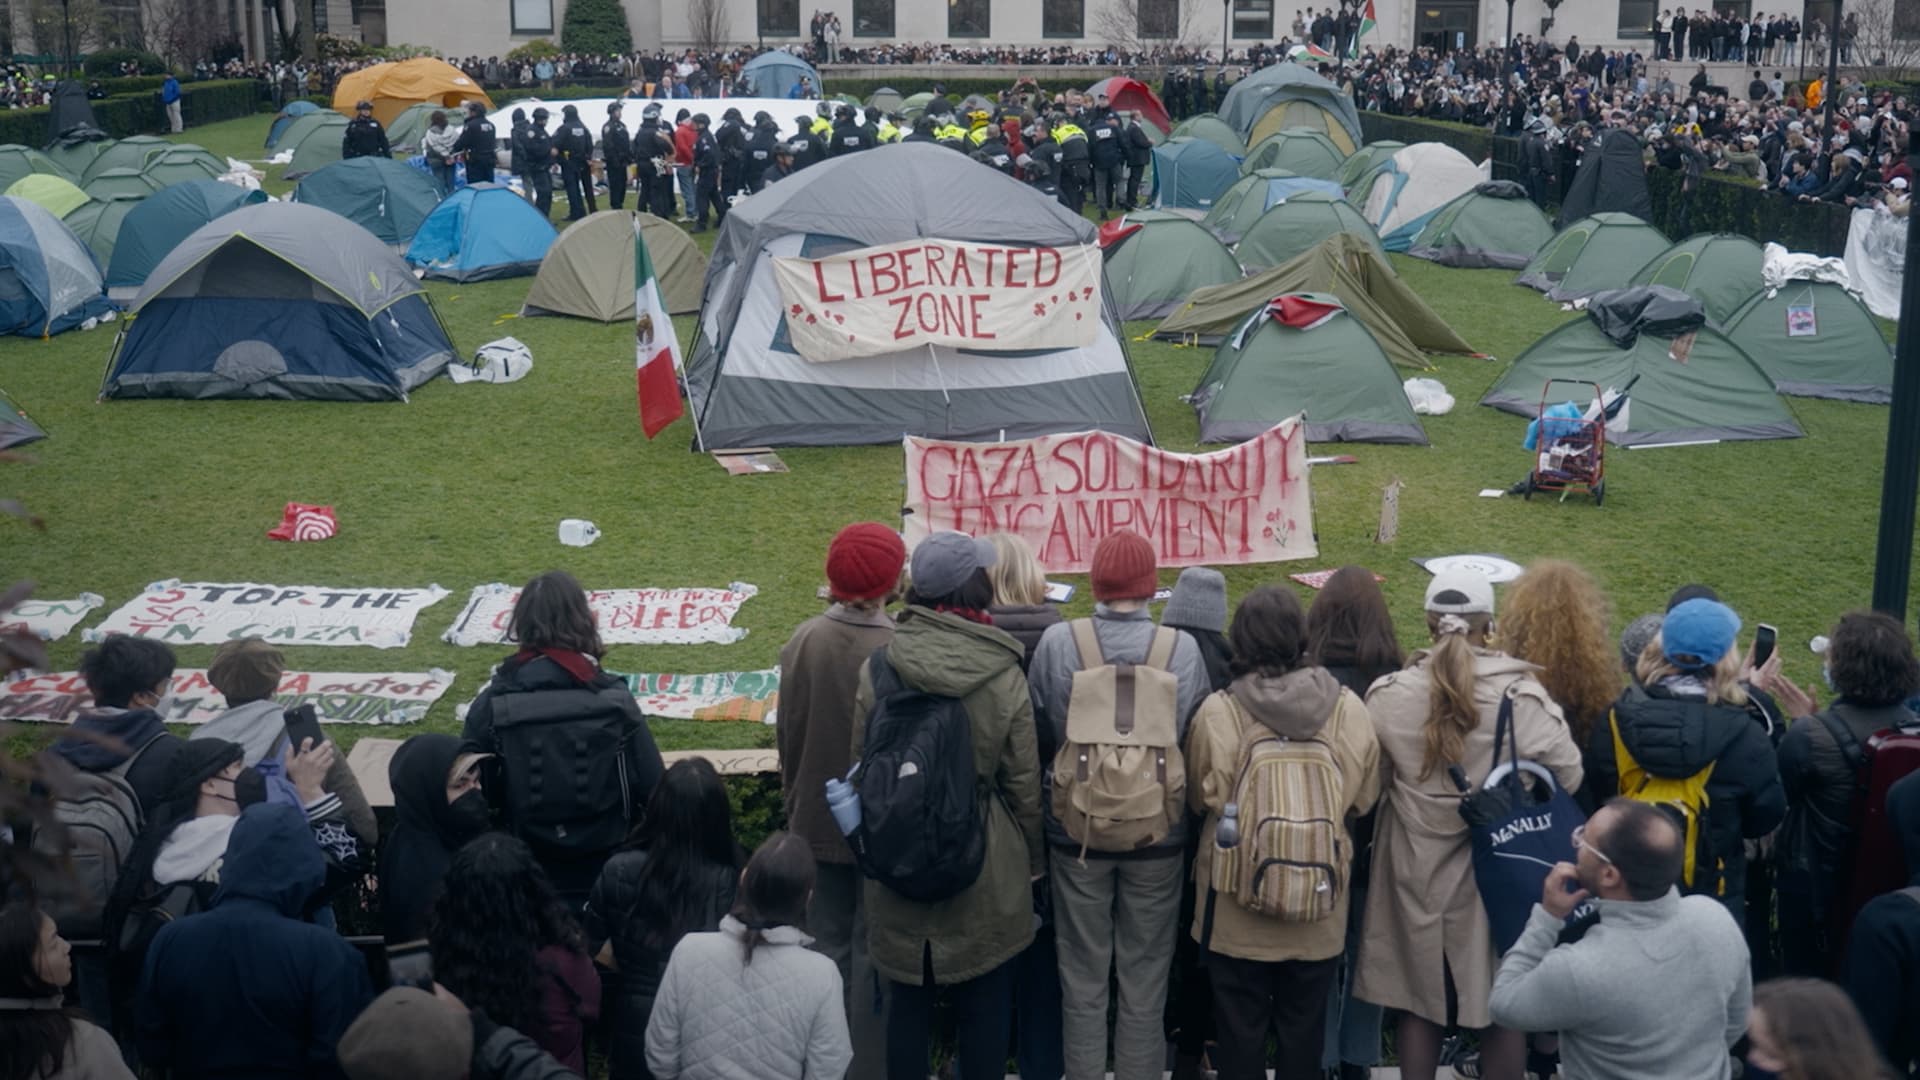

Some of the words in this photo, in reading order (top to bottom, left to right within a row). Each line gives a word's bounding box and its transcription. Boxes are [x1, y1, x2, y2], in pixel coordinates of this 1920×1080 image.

[811, 245, 1062, 303] LIBERATED
[888, 291, 997, 341] ZONE
[920, 442, 1045, 502] GAZA
[1054, 422, 1300, 495] SOLIDARITY
[952, 493, 1261, 563] ENCAMPMENT
[147, 584, 304, 606] STOP
[318, 591, 419, 610] THE
